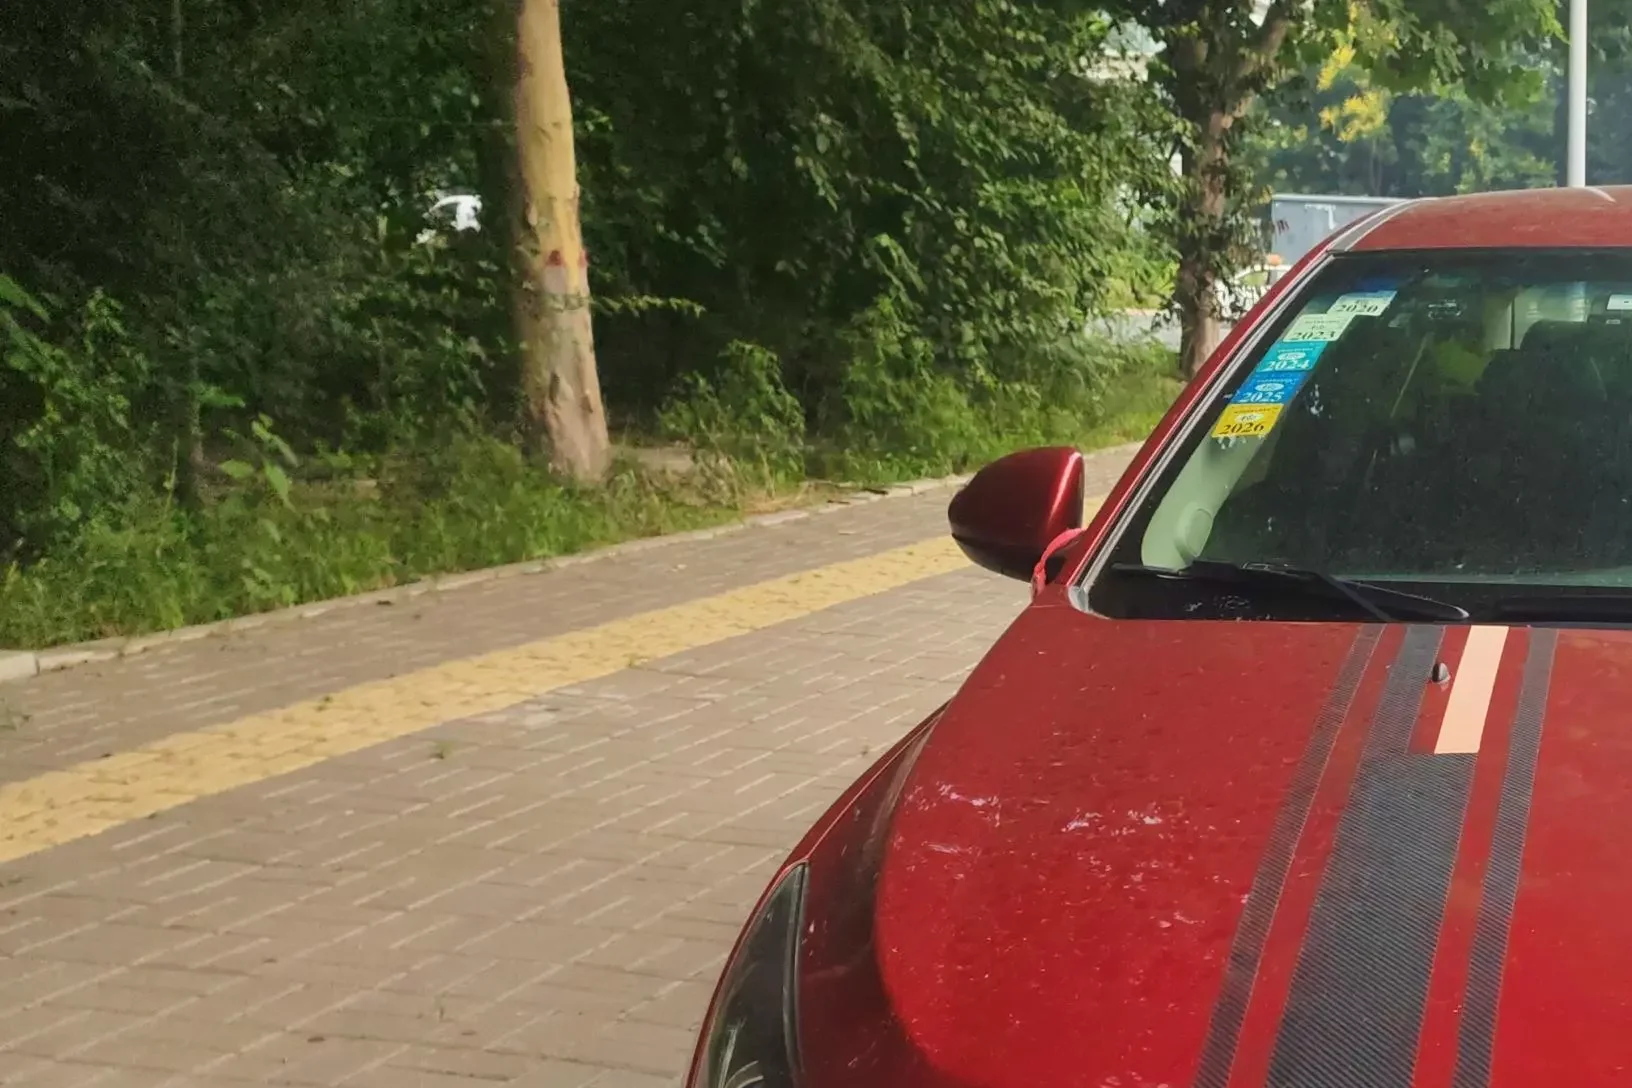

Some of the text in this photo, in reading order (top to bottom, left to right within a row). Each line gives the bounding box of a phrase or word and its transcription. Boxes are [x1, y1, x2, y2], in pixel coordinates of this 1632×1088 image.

[1263, 359, 1310, 371] 2024
[1240, 391, 1285, 403] 2025
[1217, 422, 1265, 435] 2026
